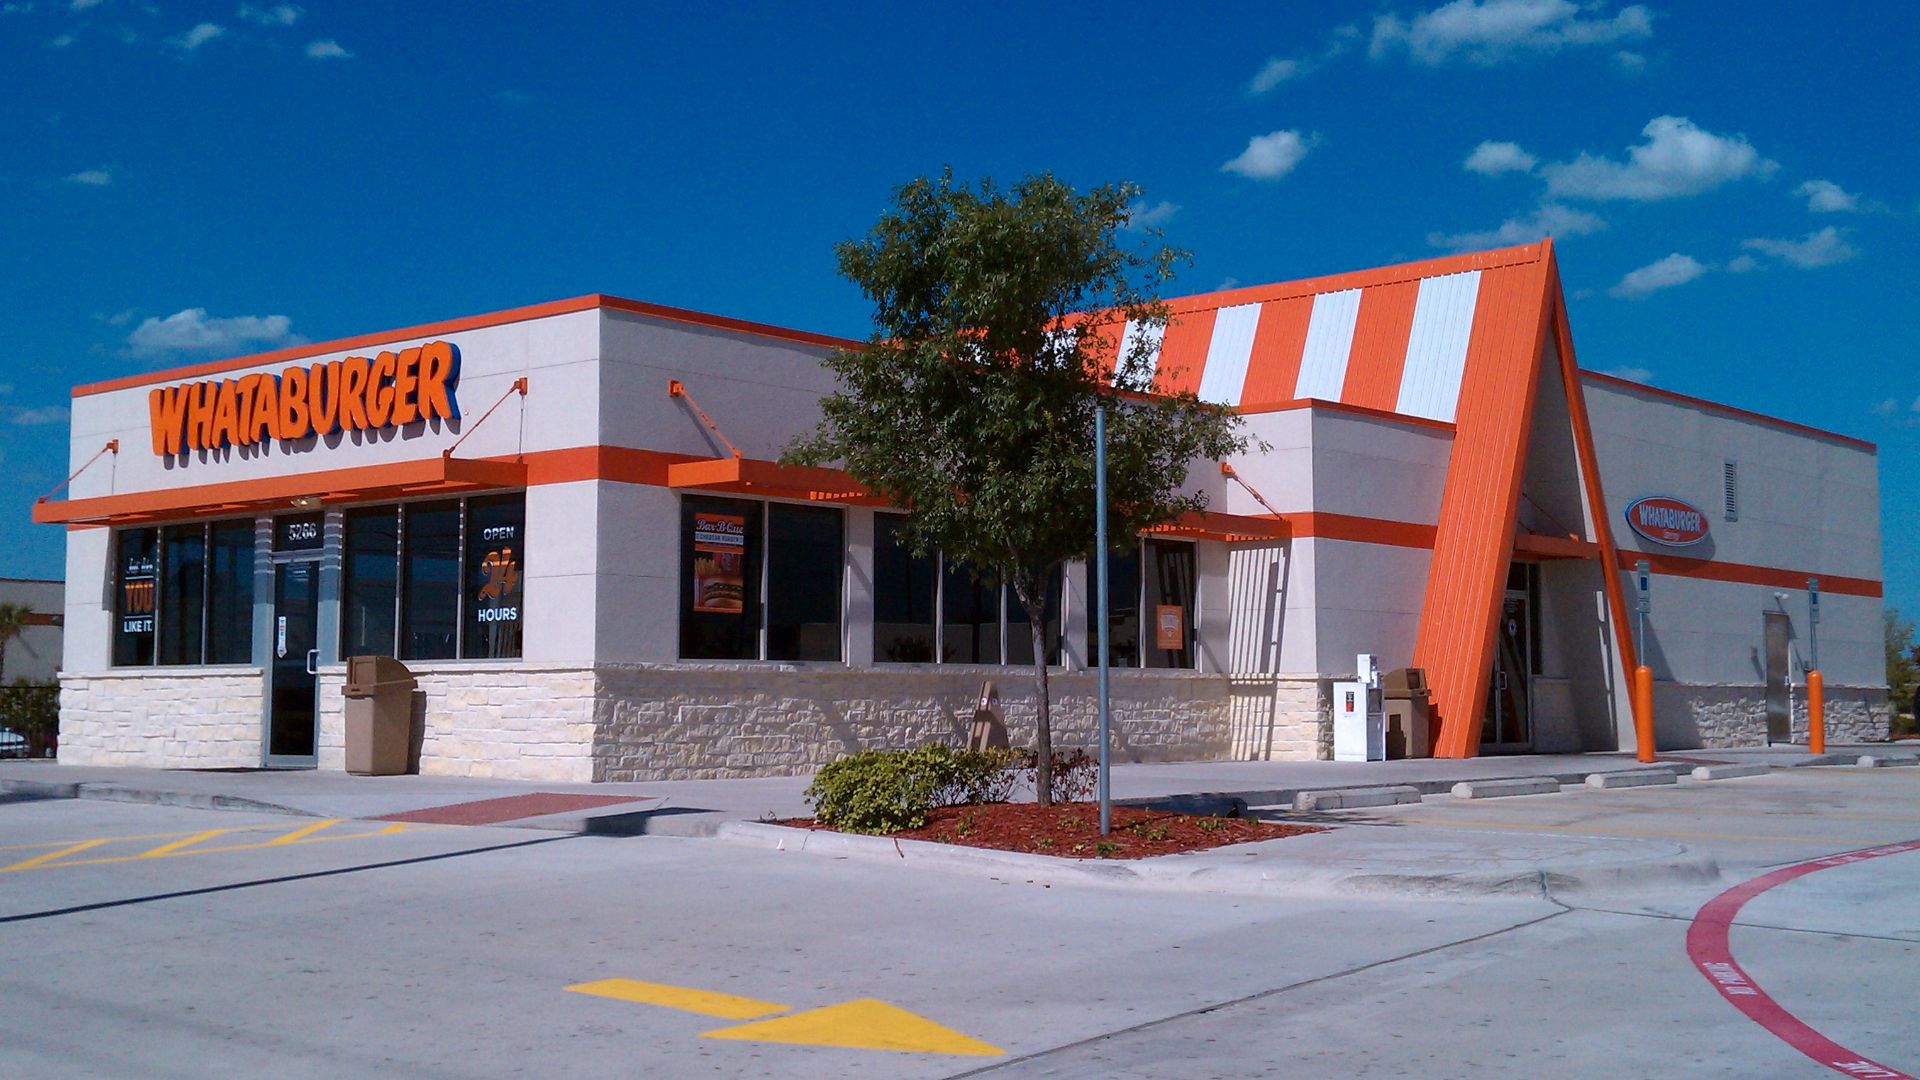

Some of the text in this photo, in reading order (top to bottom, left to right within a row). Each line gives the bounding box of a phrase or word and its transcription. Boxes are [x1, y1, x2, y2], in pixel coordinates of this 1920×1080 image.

[149, 340, 460, 457] WHATABURGER
[1639, 503, 1701, 533] WHATABURGER
[288, 522, 317, 541] 5266
[483, 526, 515, 541] OPEN
[478, 546, 517, 601] 24
[125, 581, 154, 614] YOU
[124, 620, 143, 632] LIKE
[478, 607, 517, 622] HOURS
